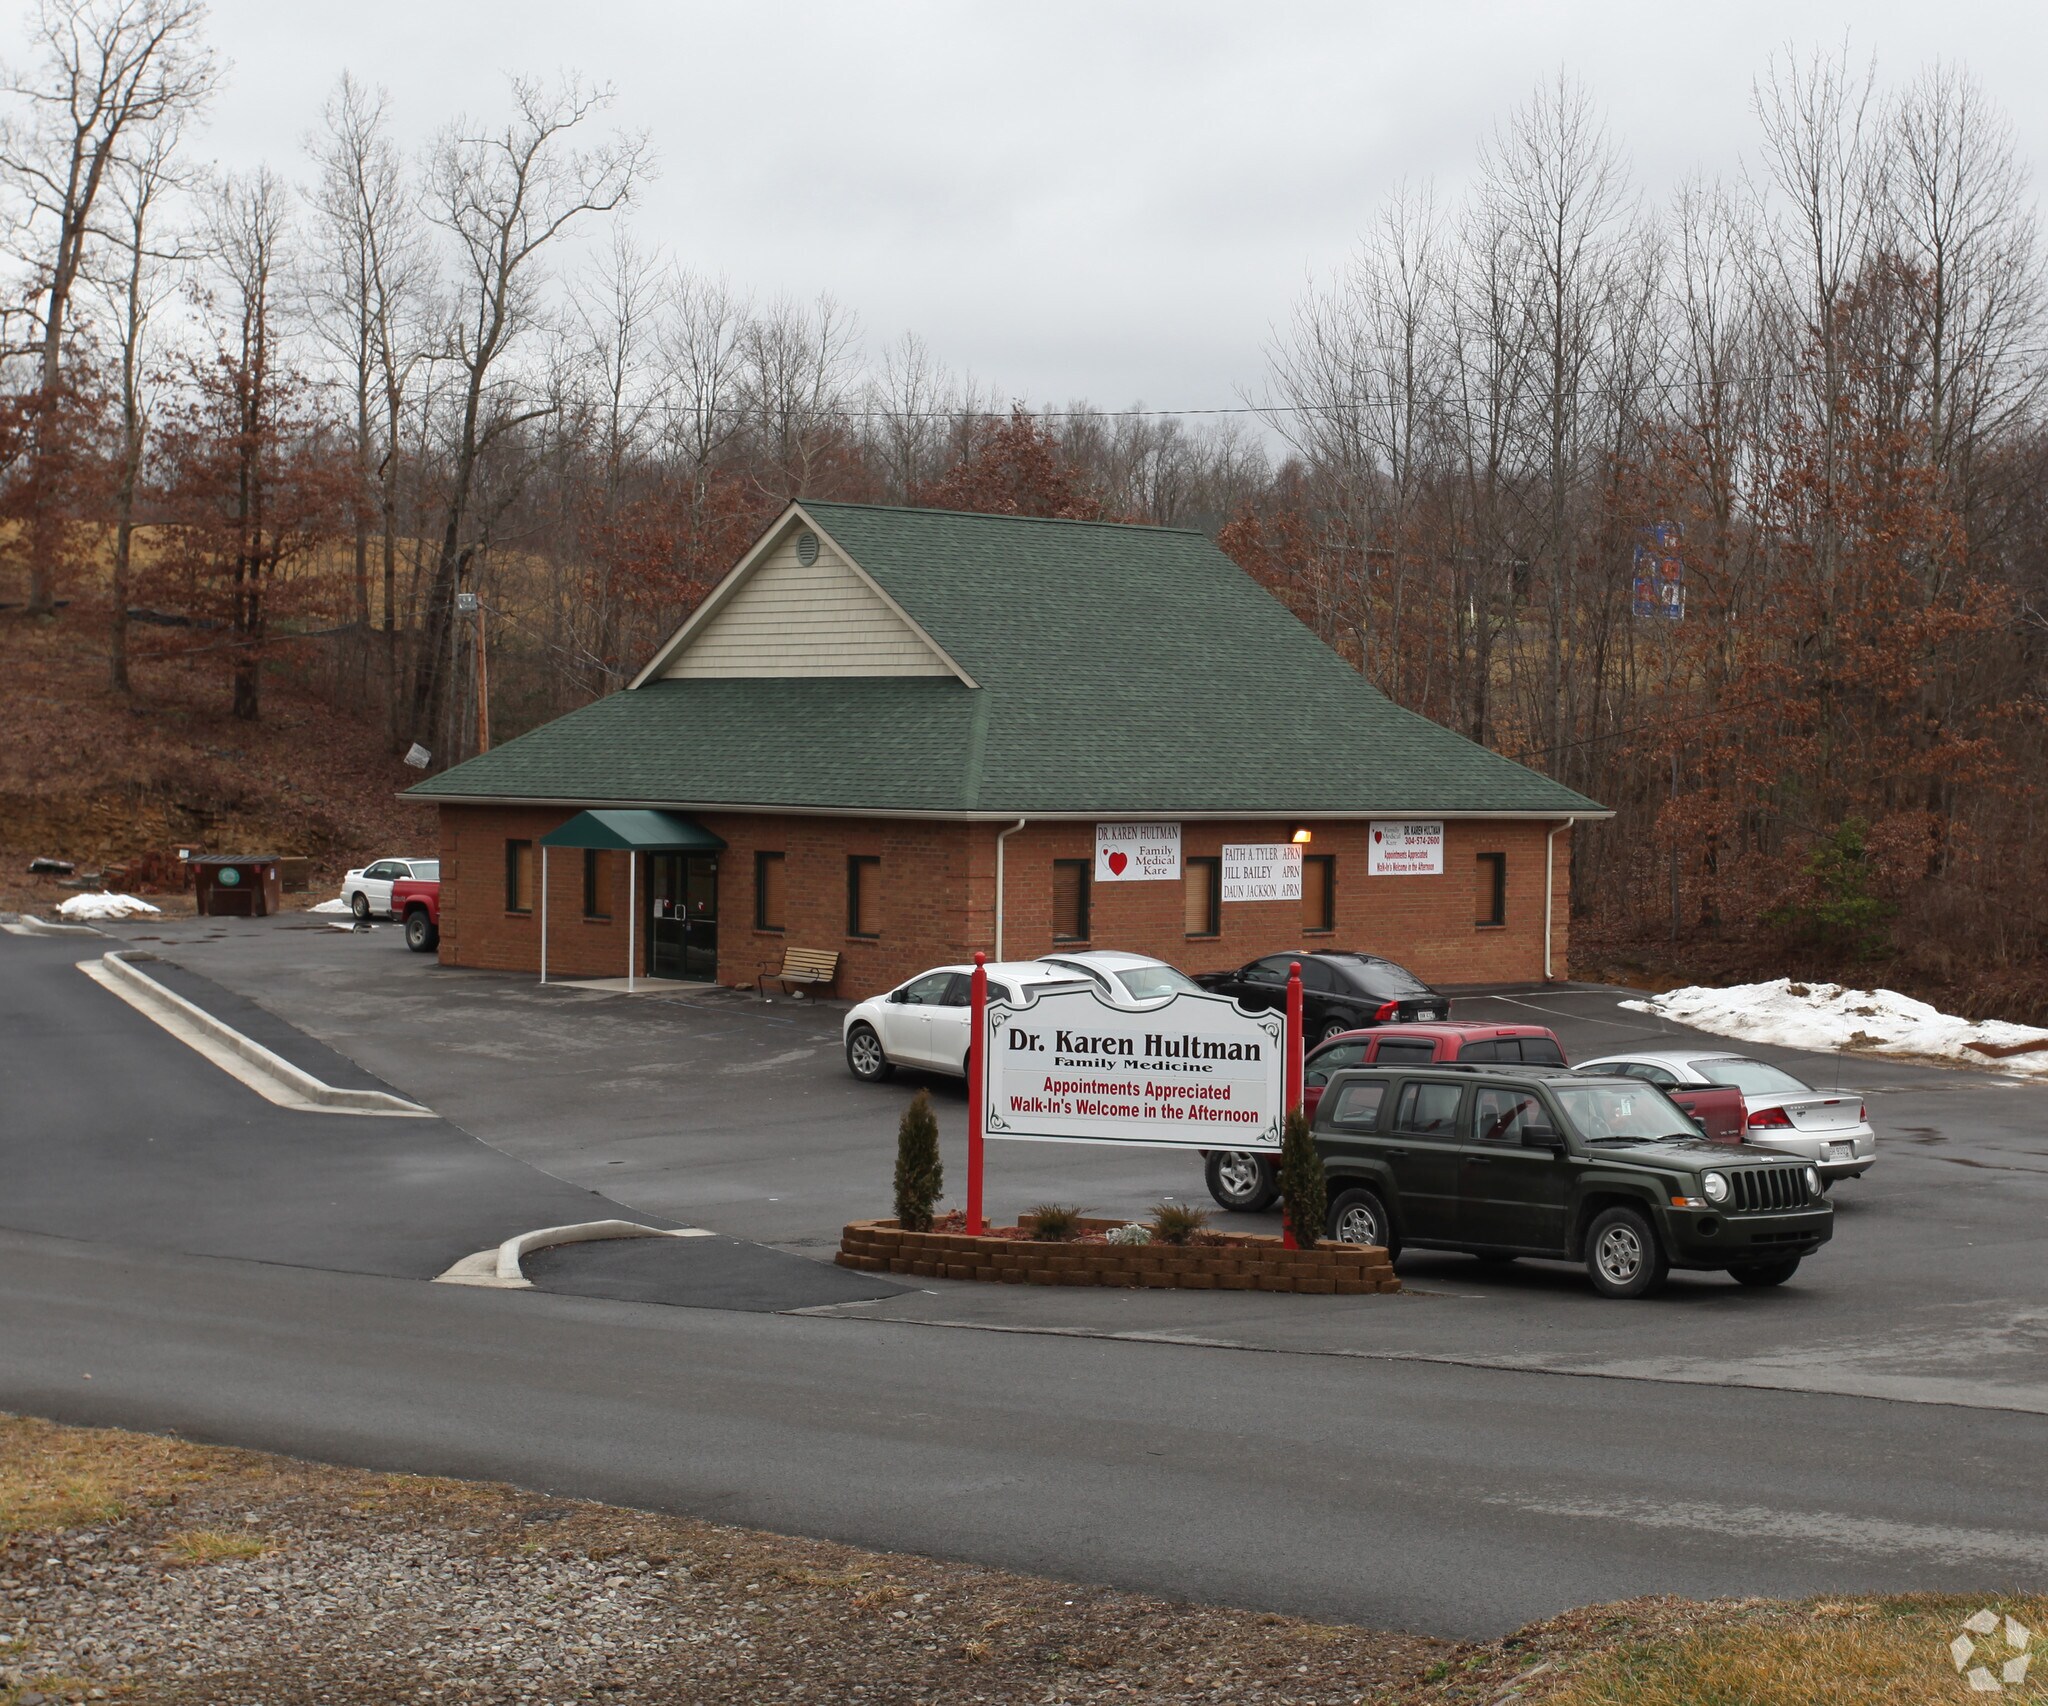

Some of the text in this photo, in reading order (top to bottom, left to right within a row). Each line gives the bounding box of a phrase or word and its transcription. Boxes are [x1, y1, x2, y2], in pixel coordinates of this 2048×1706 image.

[1098, 826, 1178, 840] DR. KAREN HULTMAN
[1411, 826, 1423, 835] KAREN
[1424, 826, 1441, 835] HULTMAN
[1405, 836, 1440, 845] 304-574-2600
[1139, 846, 1173, 857] Family
[1225, 848, 1246, 860] FAITH
[1256, 847, 1279, 860] TYLER
[1282, 847, 1300, 860] APRN
[1384, 850, 1428, 861] Appointments Appreciated
[1135, 855, 1175, 865] Medical
[1144, 866, 1168, 875] Kare
[1224, 866, 1300, 879] JILL BAILEY APRN
[1246, 884, 1277, 897] JACKSON
[1281, 884, 1300, 896] APRN
[1009, 1028, 1262, 1061] Dr. Karen Hultman
[1054, 1057, 1213, 1073] Family Medicine
[1043, 1076, 1231, 1101] Appointments Appreciated
[1010, 1096, 1259, 1123] Walk-In's Welcome in the Afternoon
